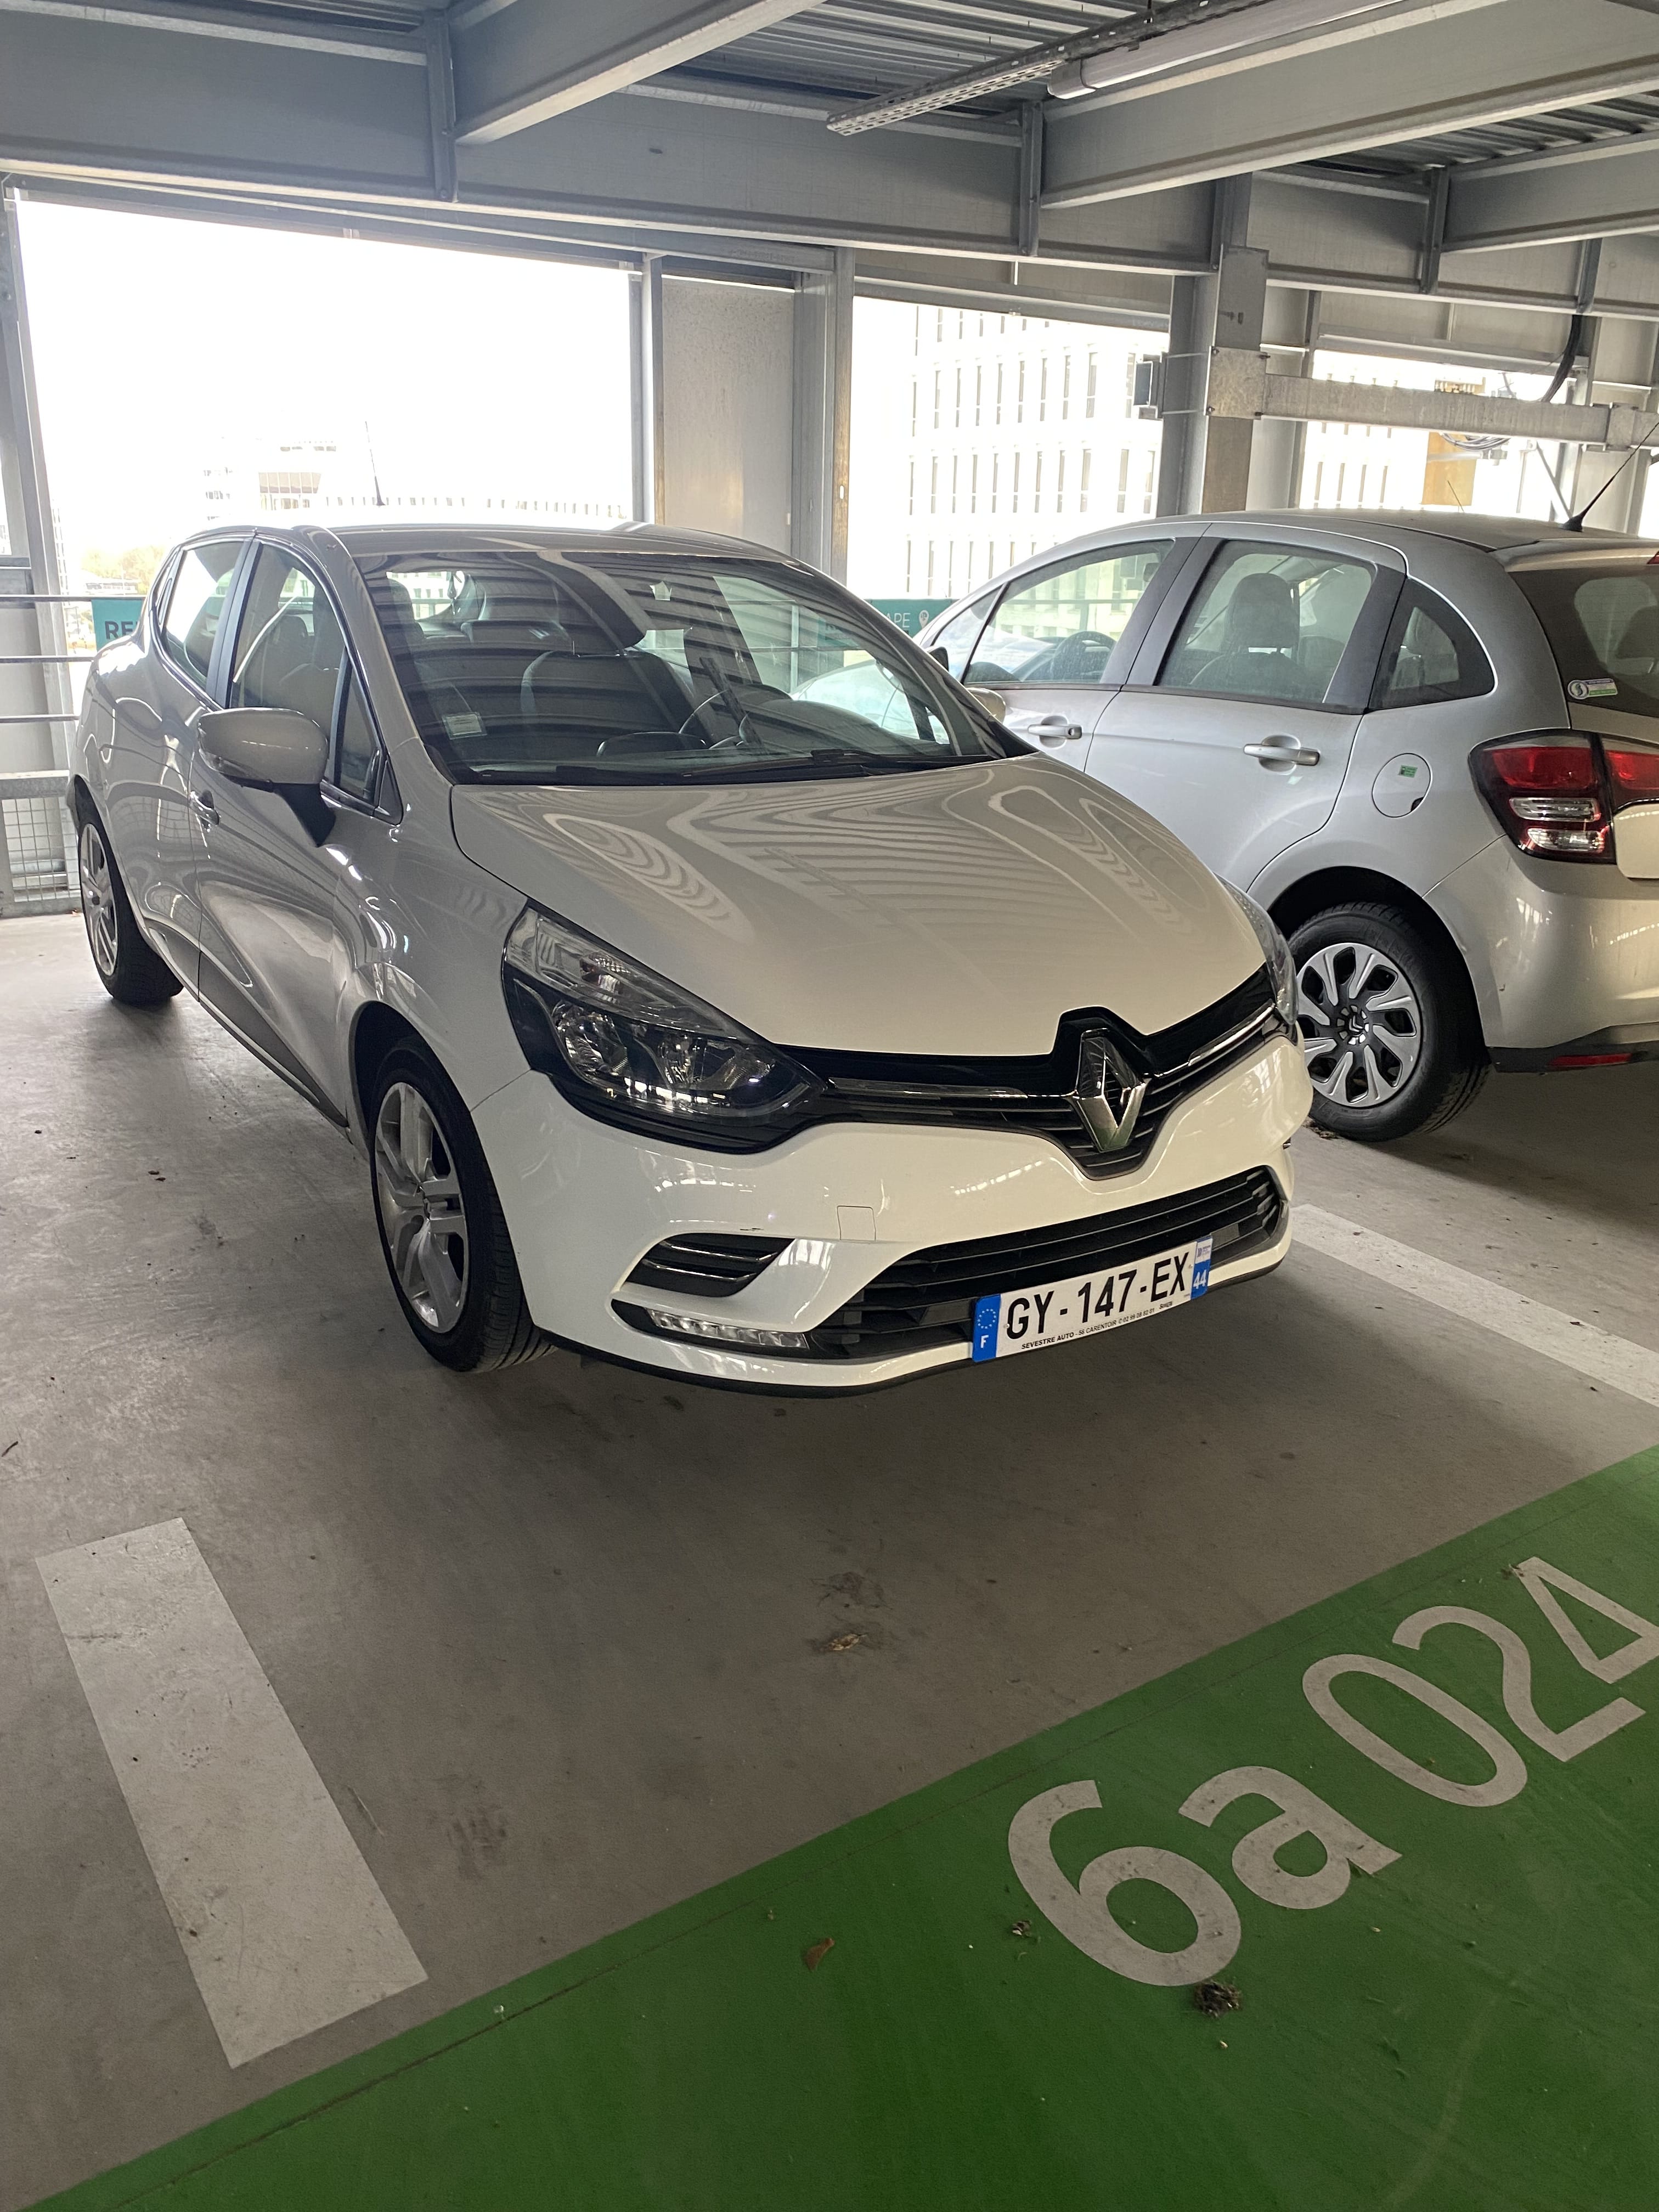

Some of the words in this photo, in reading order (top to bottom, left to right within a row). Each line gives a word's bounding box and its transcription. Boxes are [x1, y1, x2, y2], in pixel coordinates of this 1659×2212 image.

[1193, 1269, 1207, 1289] 44
[980, 1334, 989, 1348] F
[1022, 1336, 1056, 1350] SEVESTRE
[1057, 1332, 1074, 1341] AUTO
[1008, 1556, 1659, 1986] 6a024
